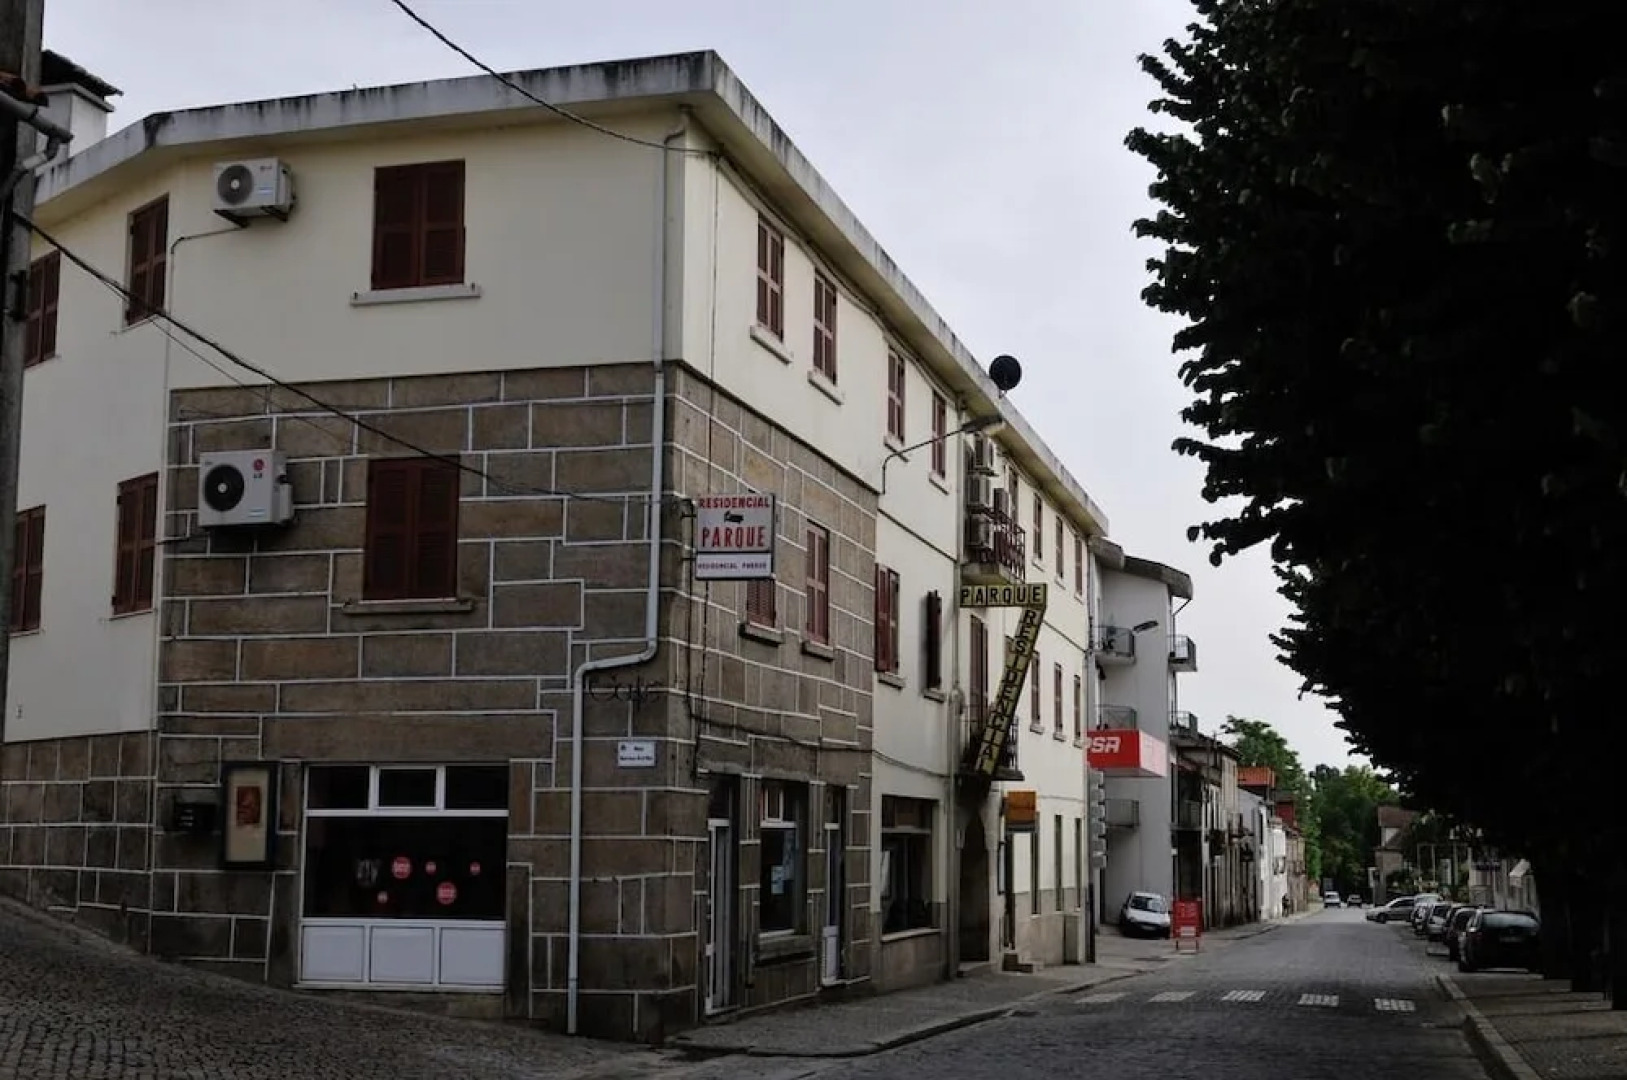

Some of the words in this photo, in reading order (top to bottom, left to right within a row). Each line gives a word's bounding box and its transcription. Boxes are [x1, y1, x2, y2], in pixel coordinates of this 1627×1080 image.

[698, 496, 770, 509] RESIDENCIAL
[702, 526, 765, 549] PARQUE
[961, 586, 1042, 604] PARQUE
